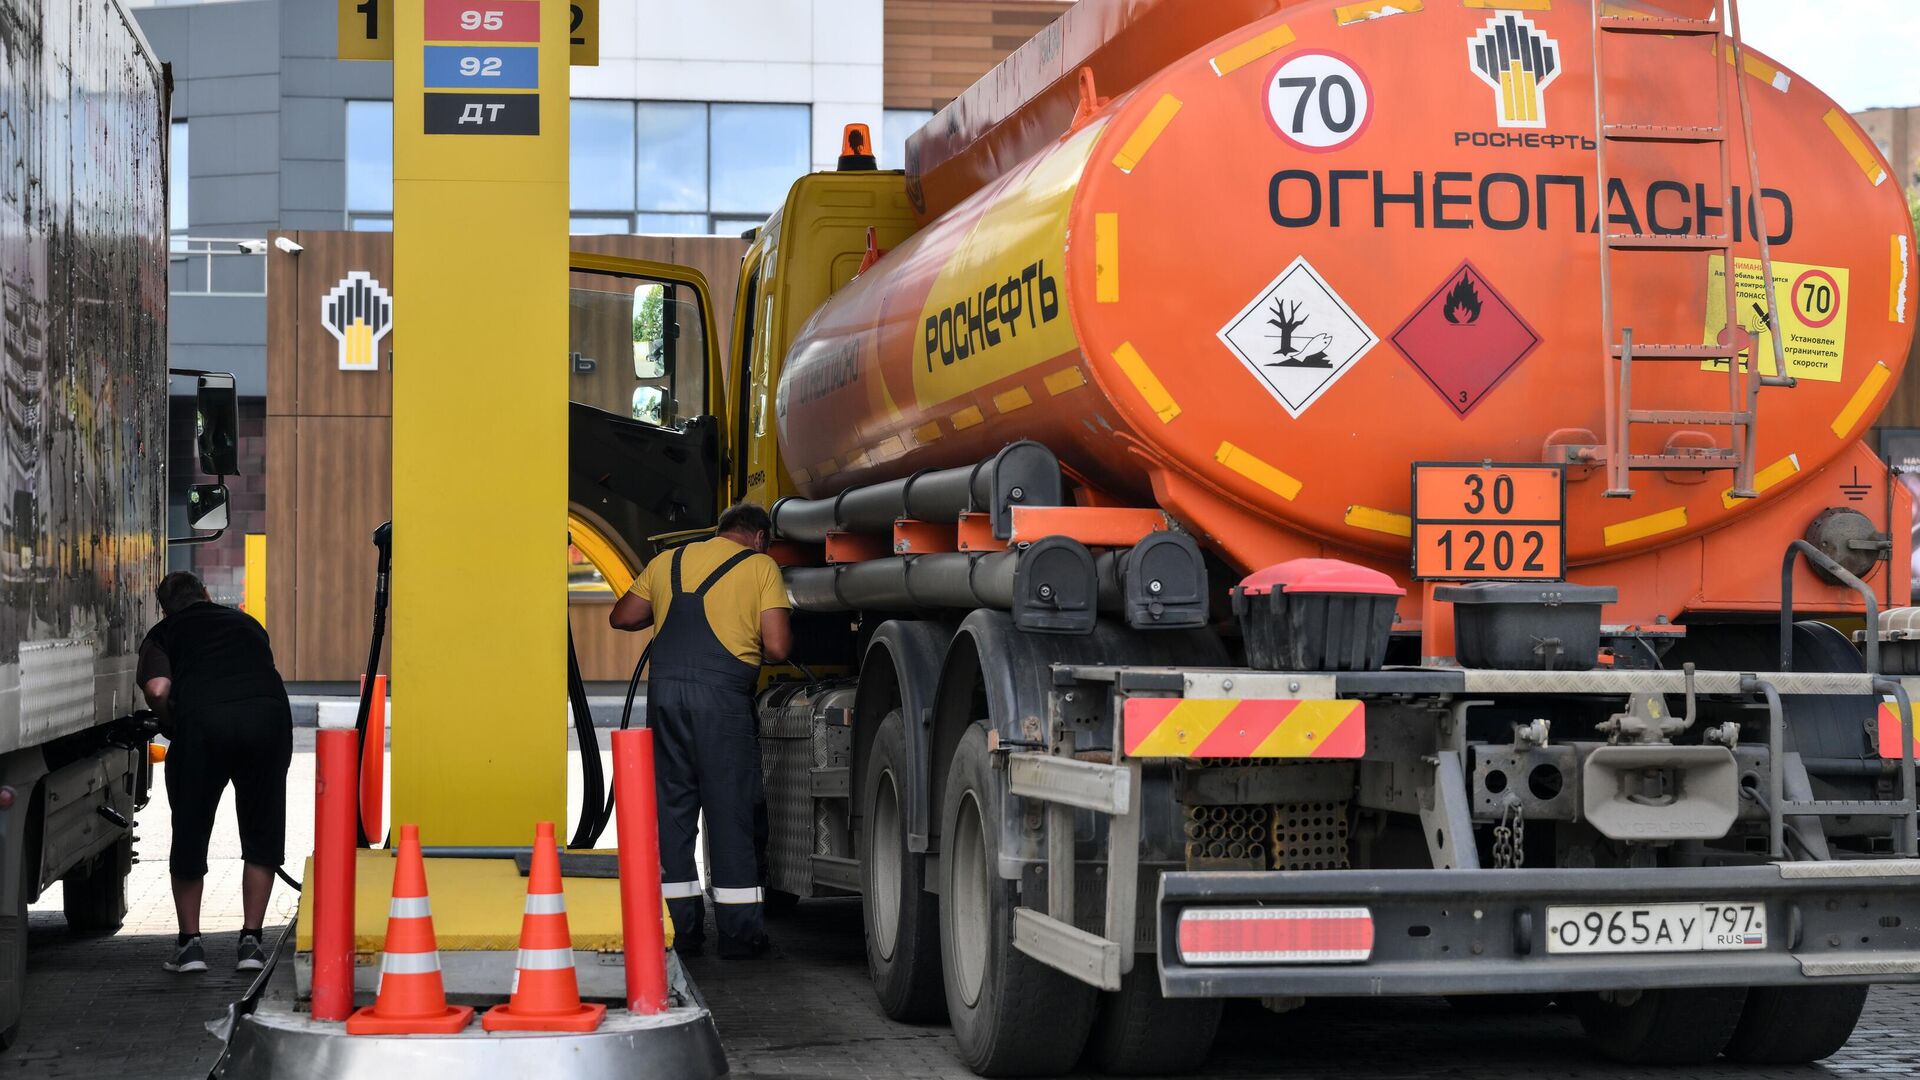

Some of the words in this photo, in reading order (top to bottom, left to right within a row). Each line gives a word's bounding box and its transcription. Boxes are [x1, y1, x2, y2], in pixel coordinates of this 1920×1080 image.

[357, 0, 378, 39] 1
[460, 10, 504, 31] 95
[459, 57, 503, 77] 92
[1278, 74, 1356, 133] 70
[458, 104, 505, 125] ДТ
[1454, 131, 1597, 150] РОСНЕФТЬ
[1268, 169, 1793, 246] ОГНЕОПАСНО
[1736, 291, 1766, 300] ГЛОНАСС
[1803, 283, 1831, 314] 70
[925, 258, 1059, 373] РОСНЕФТЬ
[1790, 334, 1835, 346] Установлен
[1784, 347, 1839, 358] ограничитель
[1793, 359, 1828, 369] скорости
[1459, 391, 1468, 403] 3
[1464, 474, 1514, 514] 30
[1437, 530, 1544, 571] 1202
[1559, 911, 1696, 946] О965АУ
[1705, 906, 1755, 933] 797
[1717, 934, 1743, 945] RUS
